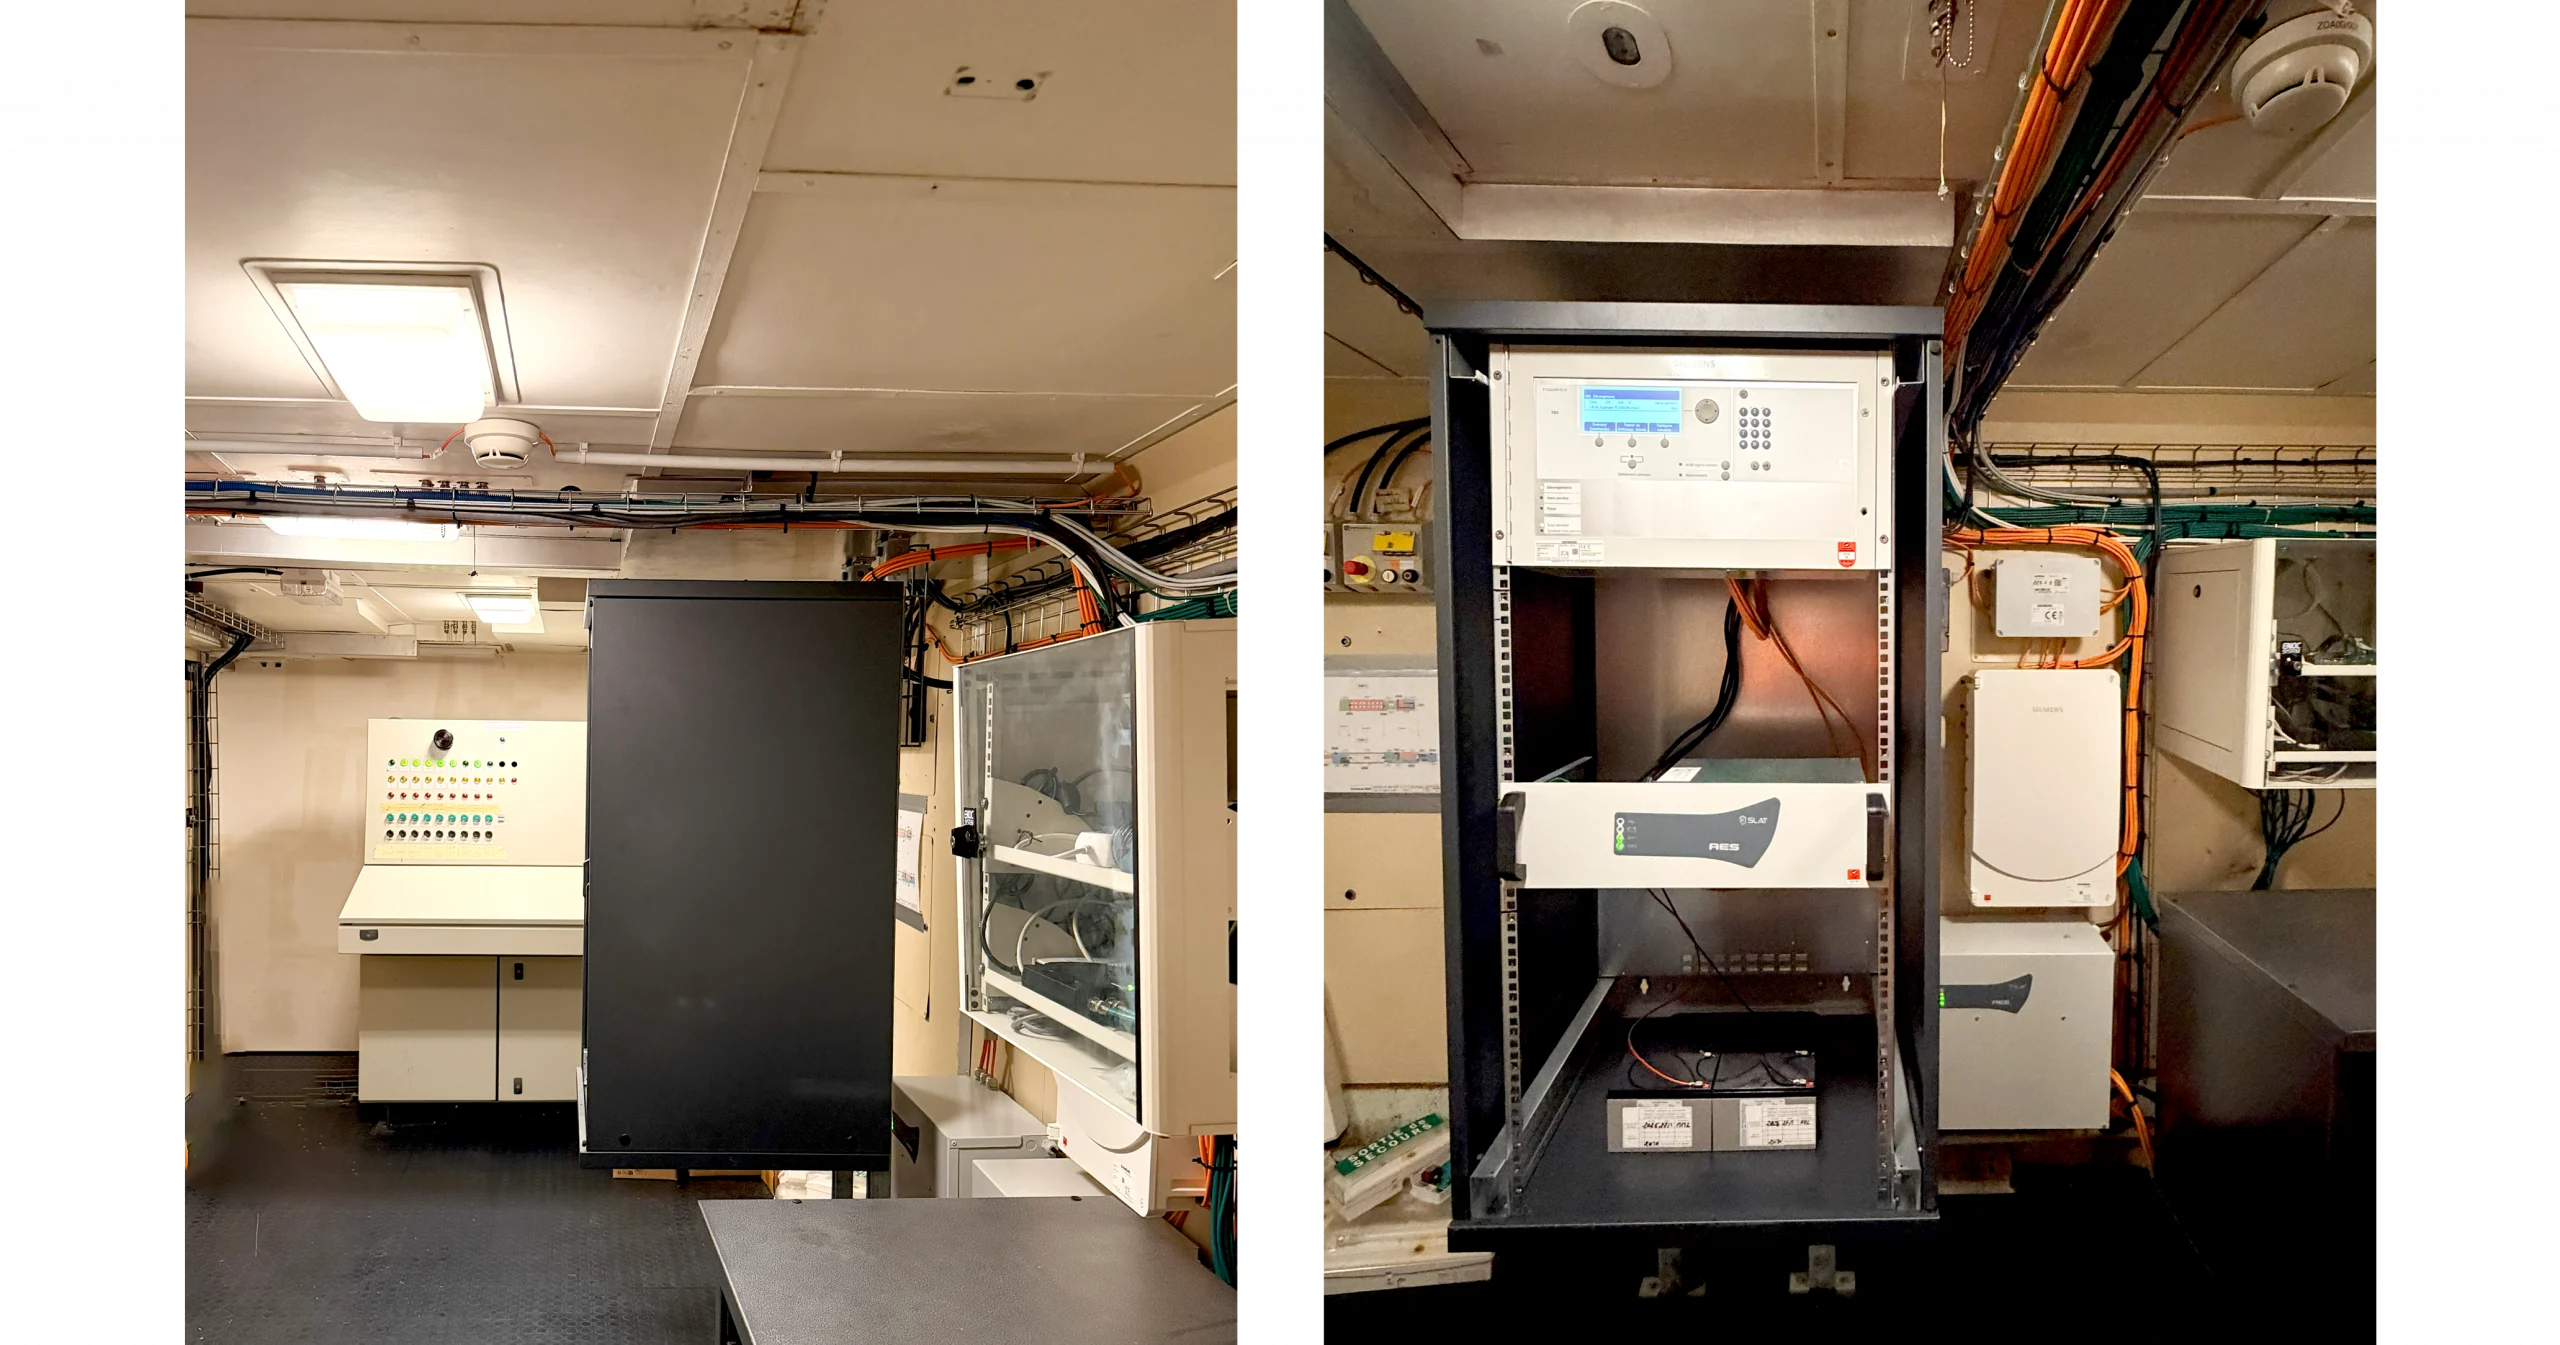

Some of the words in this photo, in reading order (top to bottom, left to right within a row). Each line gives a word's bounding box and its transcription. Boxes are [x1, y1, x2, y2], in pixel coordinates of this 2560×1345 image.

[1708, 842, 1740, 851] AES
[1348, 1128, 1406, 1162] SORTIE
[1410, 1120, 1426, 1130] de
[1353, 1123, 1432, 1168] SECOURS
